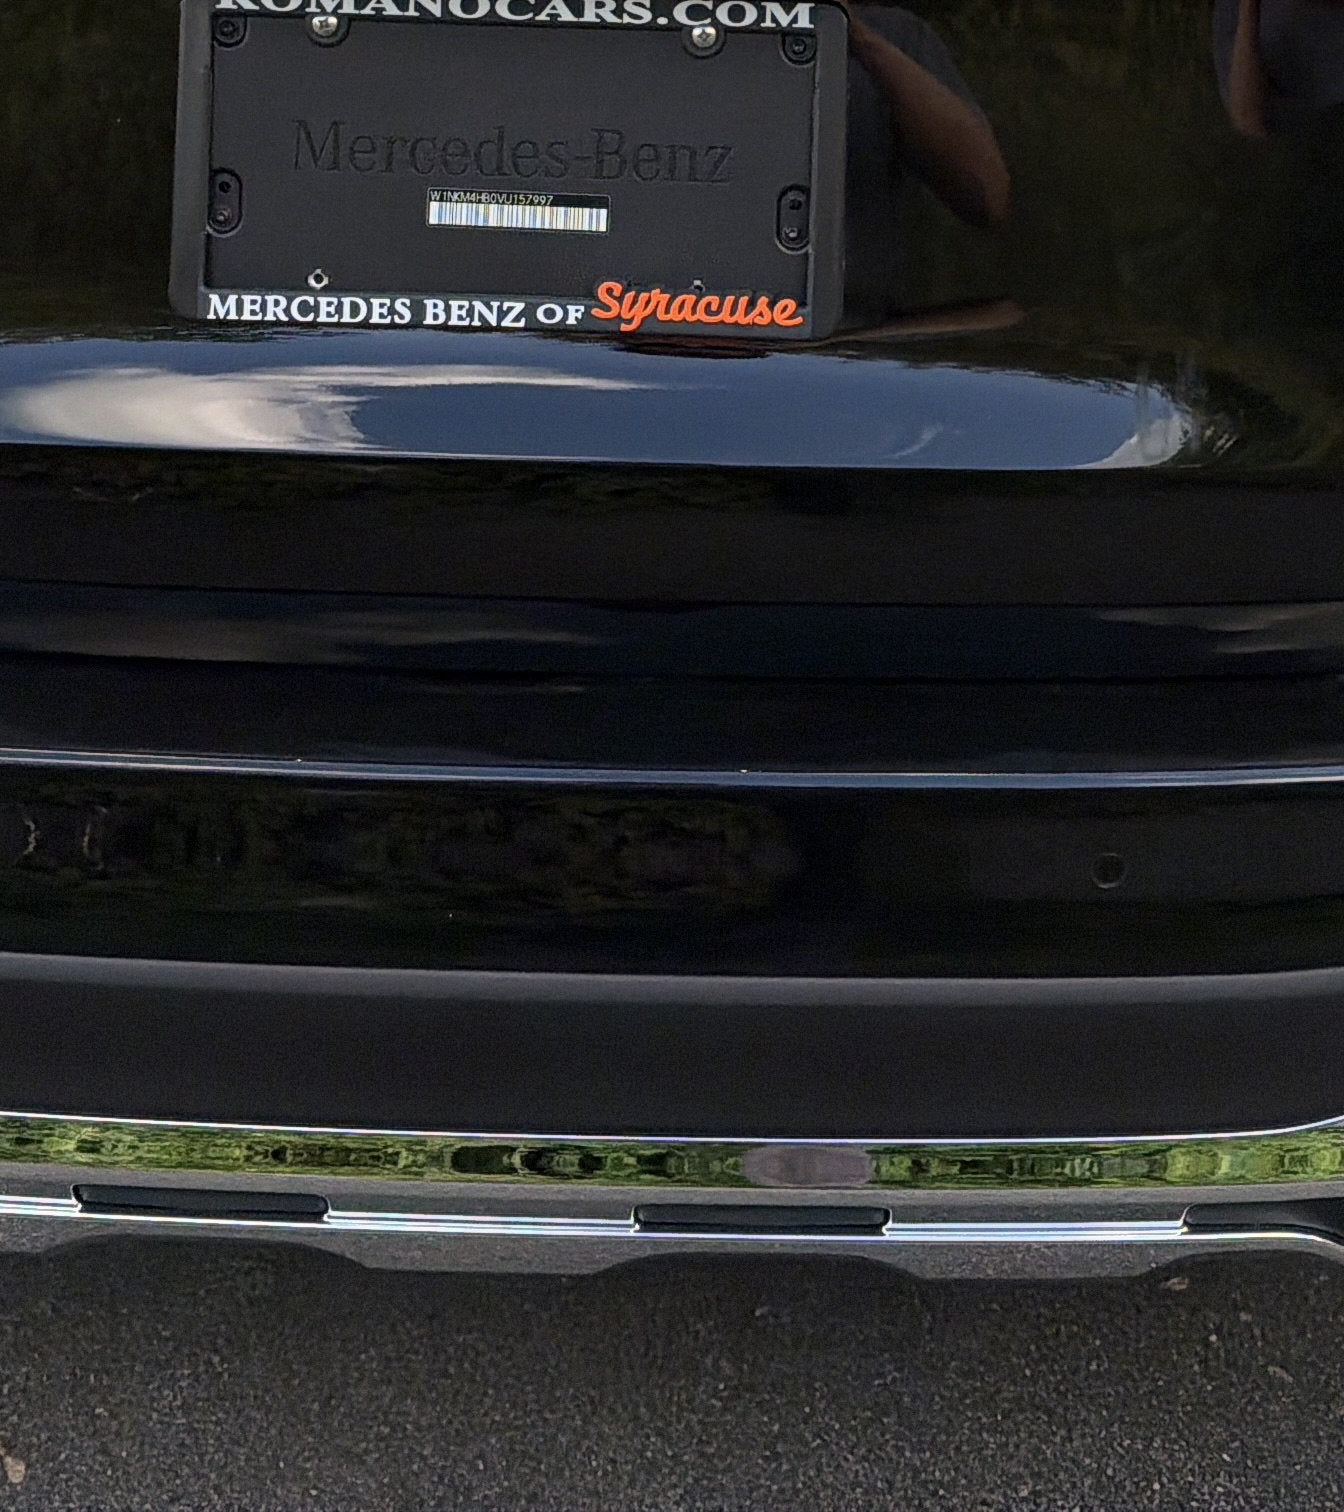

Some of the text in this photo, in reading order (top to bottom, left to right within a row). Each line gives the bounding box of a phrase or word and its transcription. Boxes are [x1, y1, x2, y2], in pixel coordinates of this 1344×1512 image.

[292, 118, 734, 184] Mercedes-Benz
[206, 281, 803, 332] MERCEDES BENZ OF Syracuse
